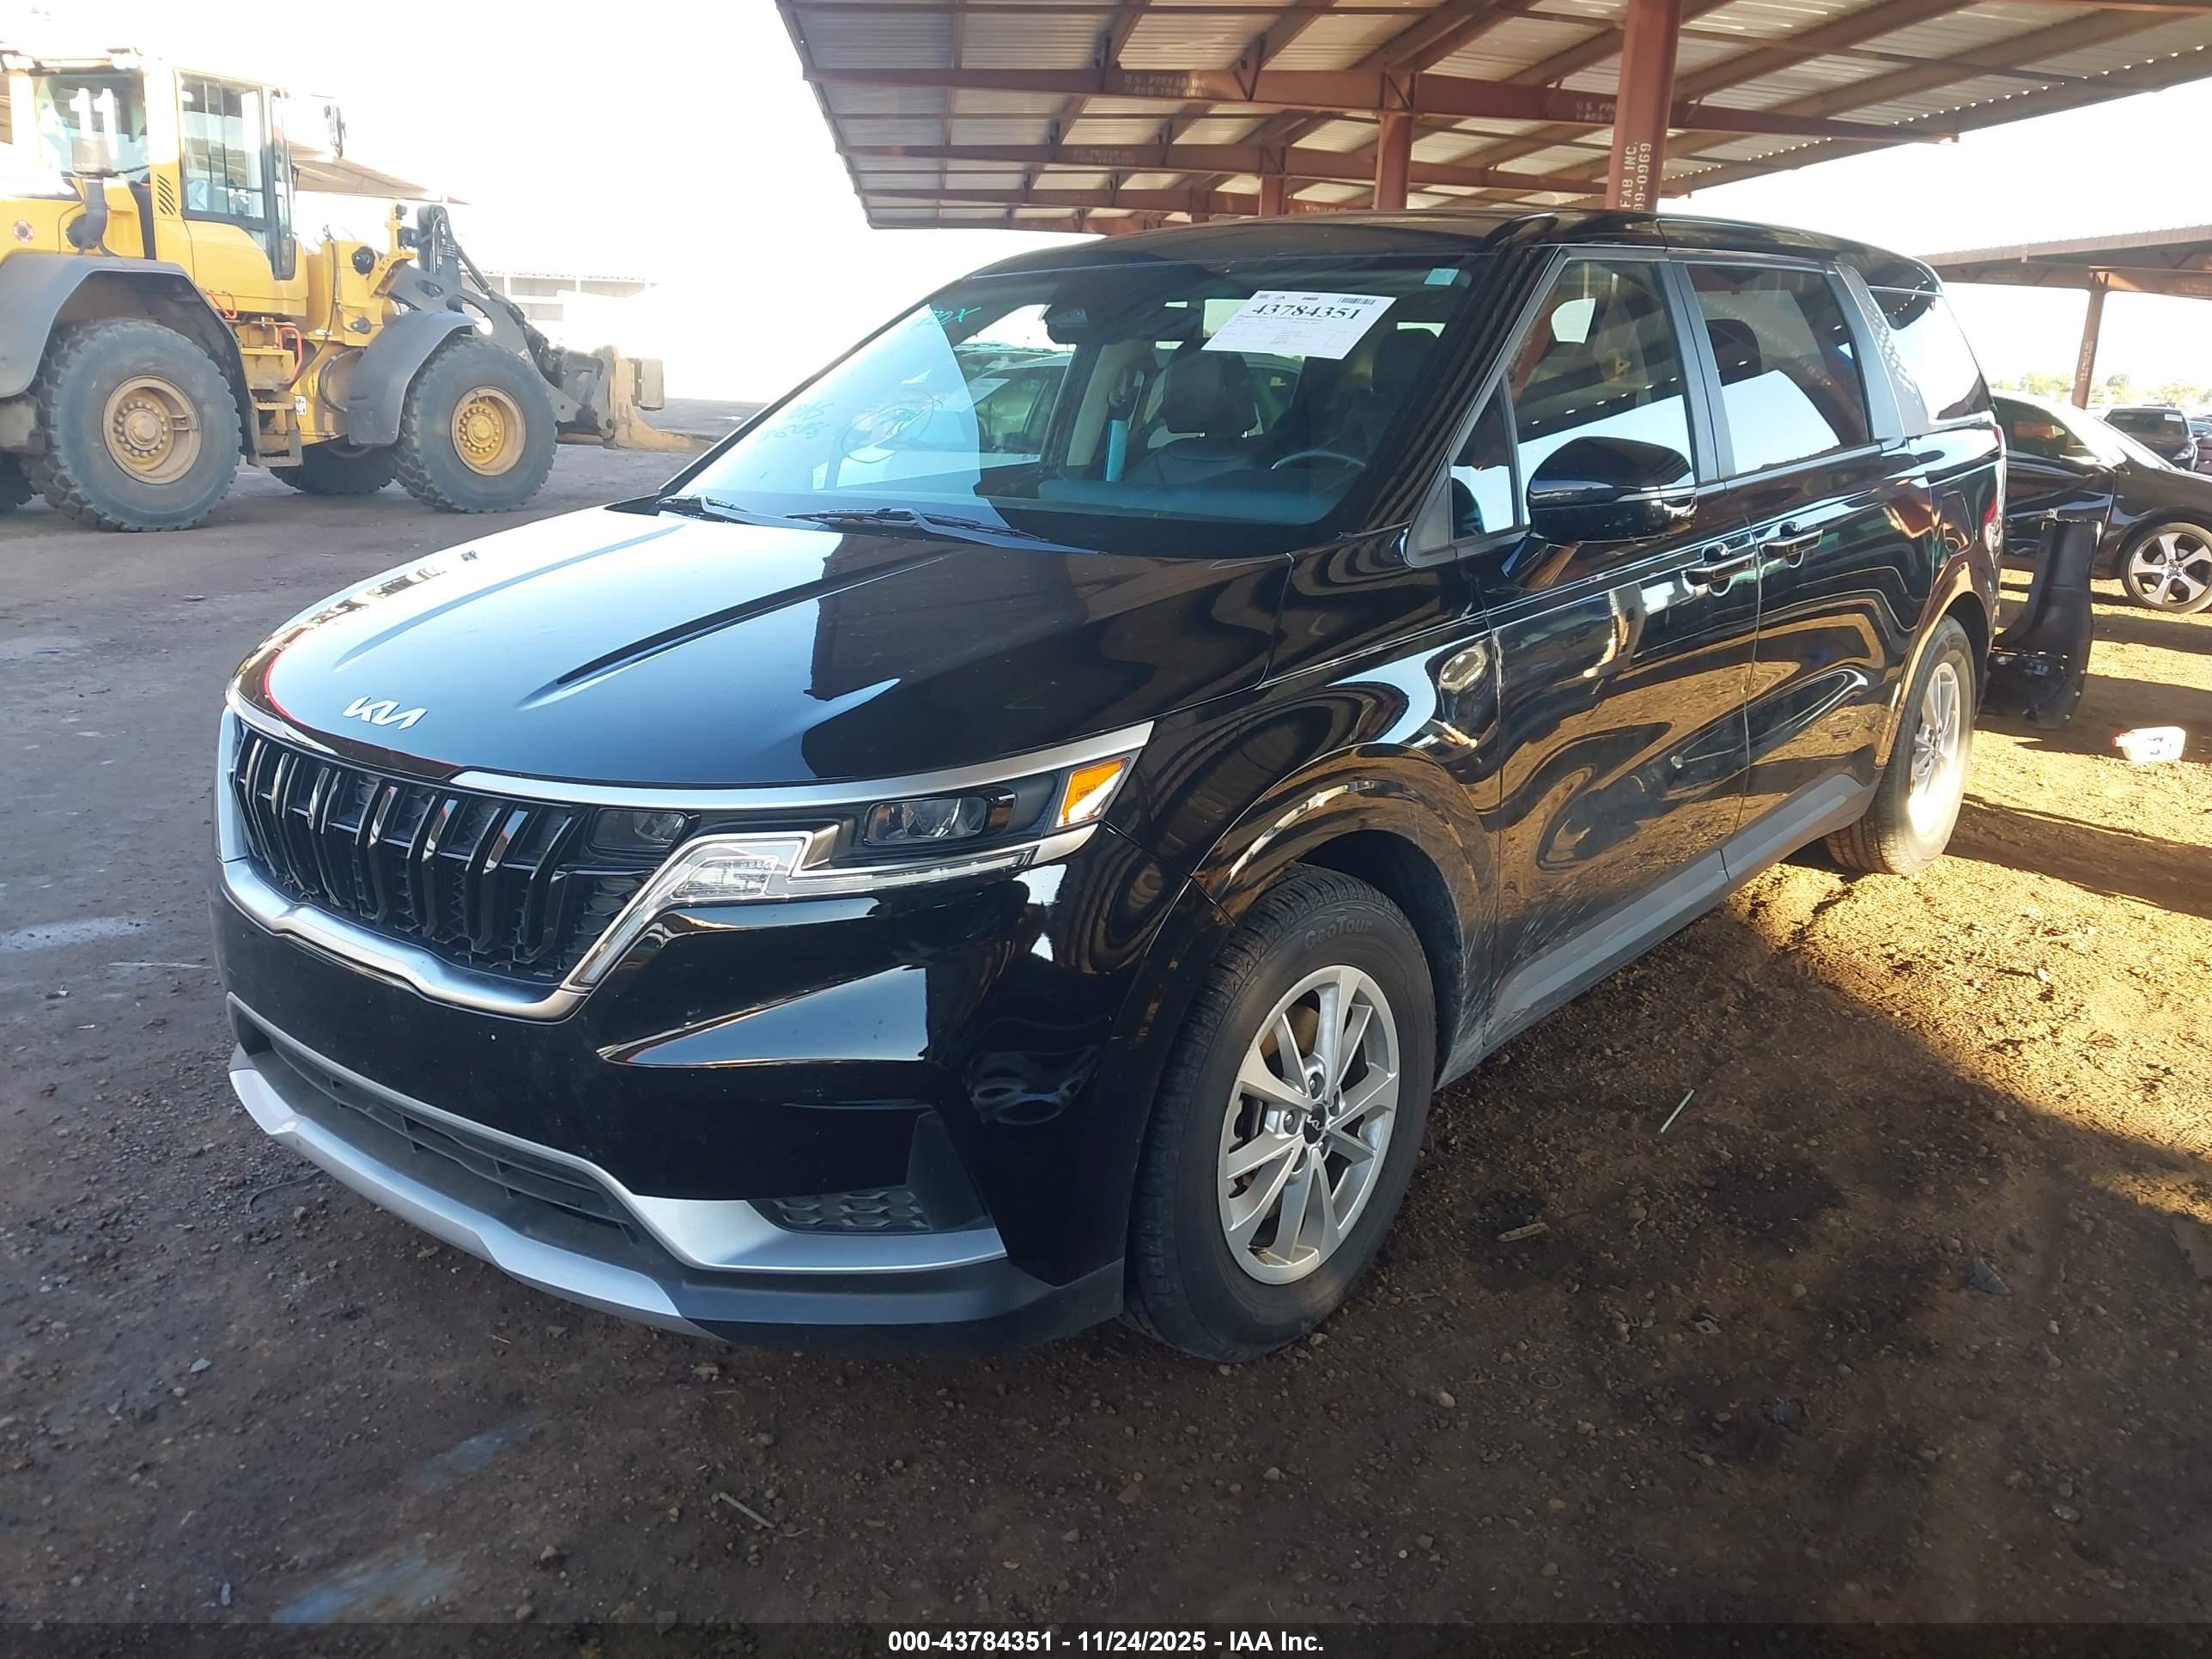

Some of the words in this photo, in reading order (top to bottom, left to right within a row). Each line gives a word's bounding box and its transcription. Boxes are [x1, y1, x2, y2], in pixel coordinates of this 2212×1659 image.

[1623, 141, 1638, 171] INC.
[1252, 303, 1362, 320] 43784351
[343, 696, 428, 730] KIA
[1304, 915, 1373, 951] GeoTour
